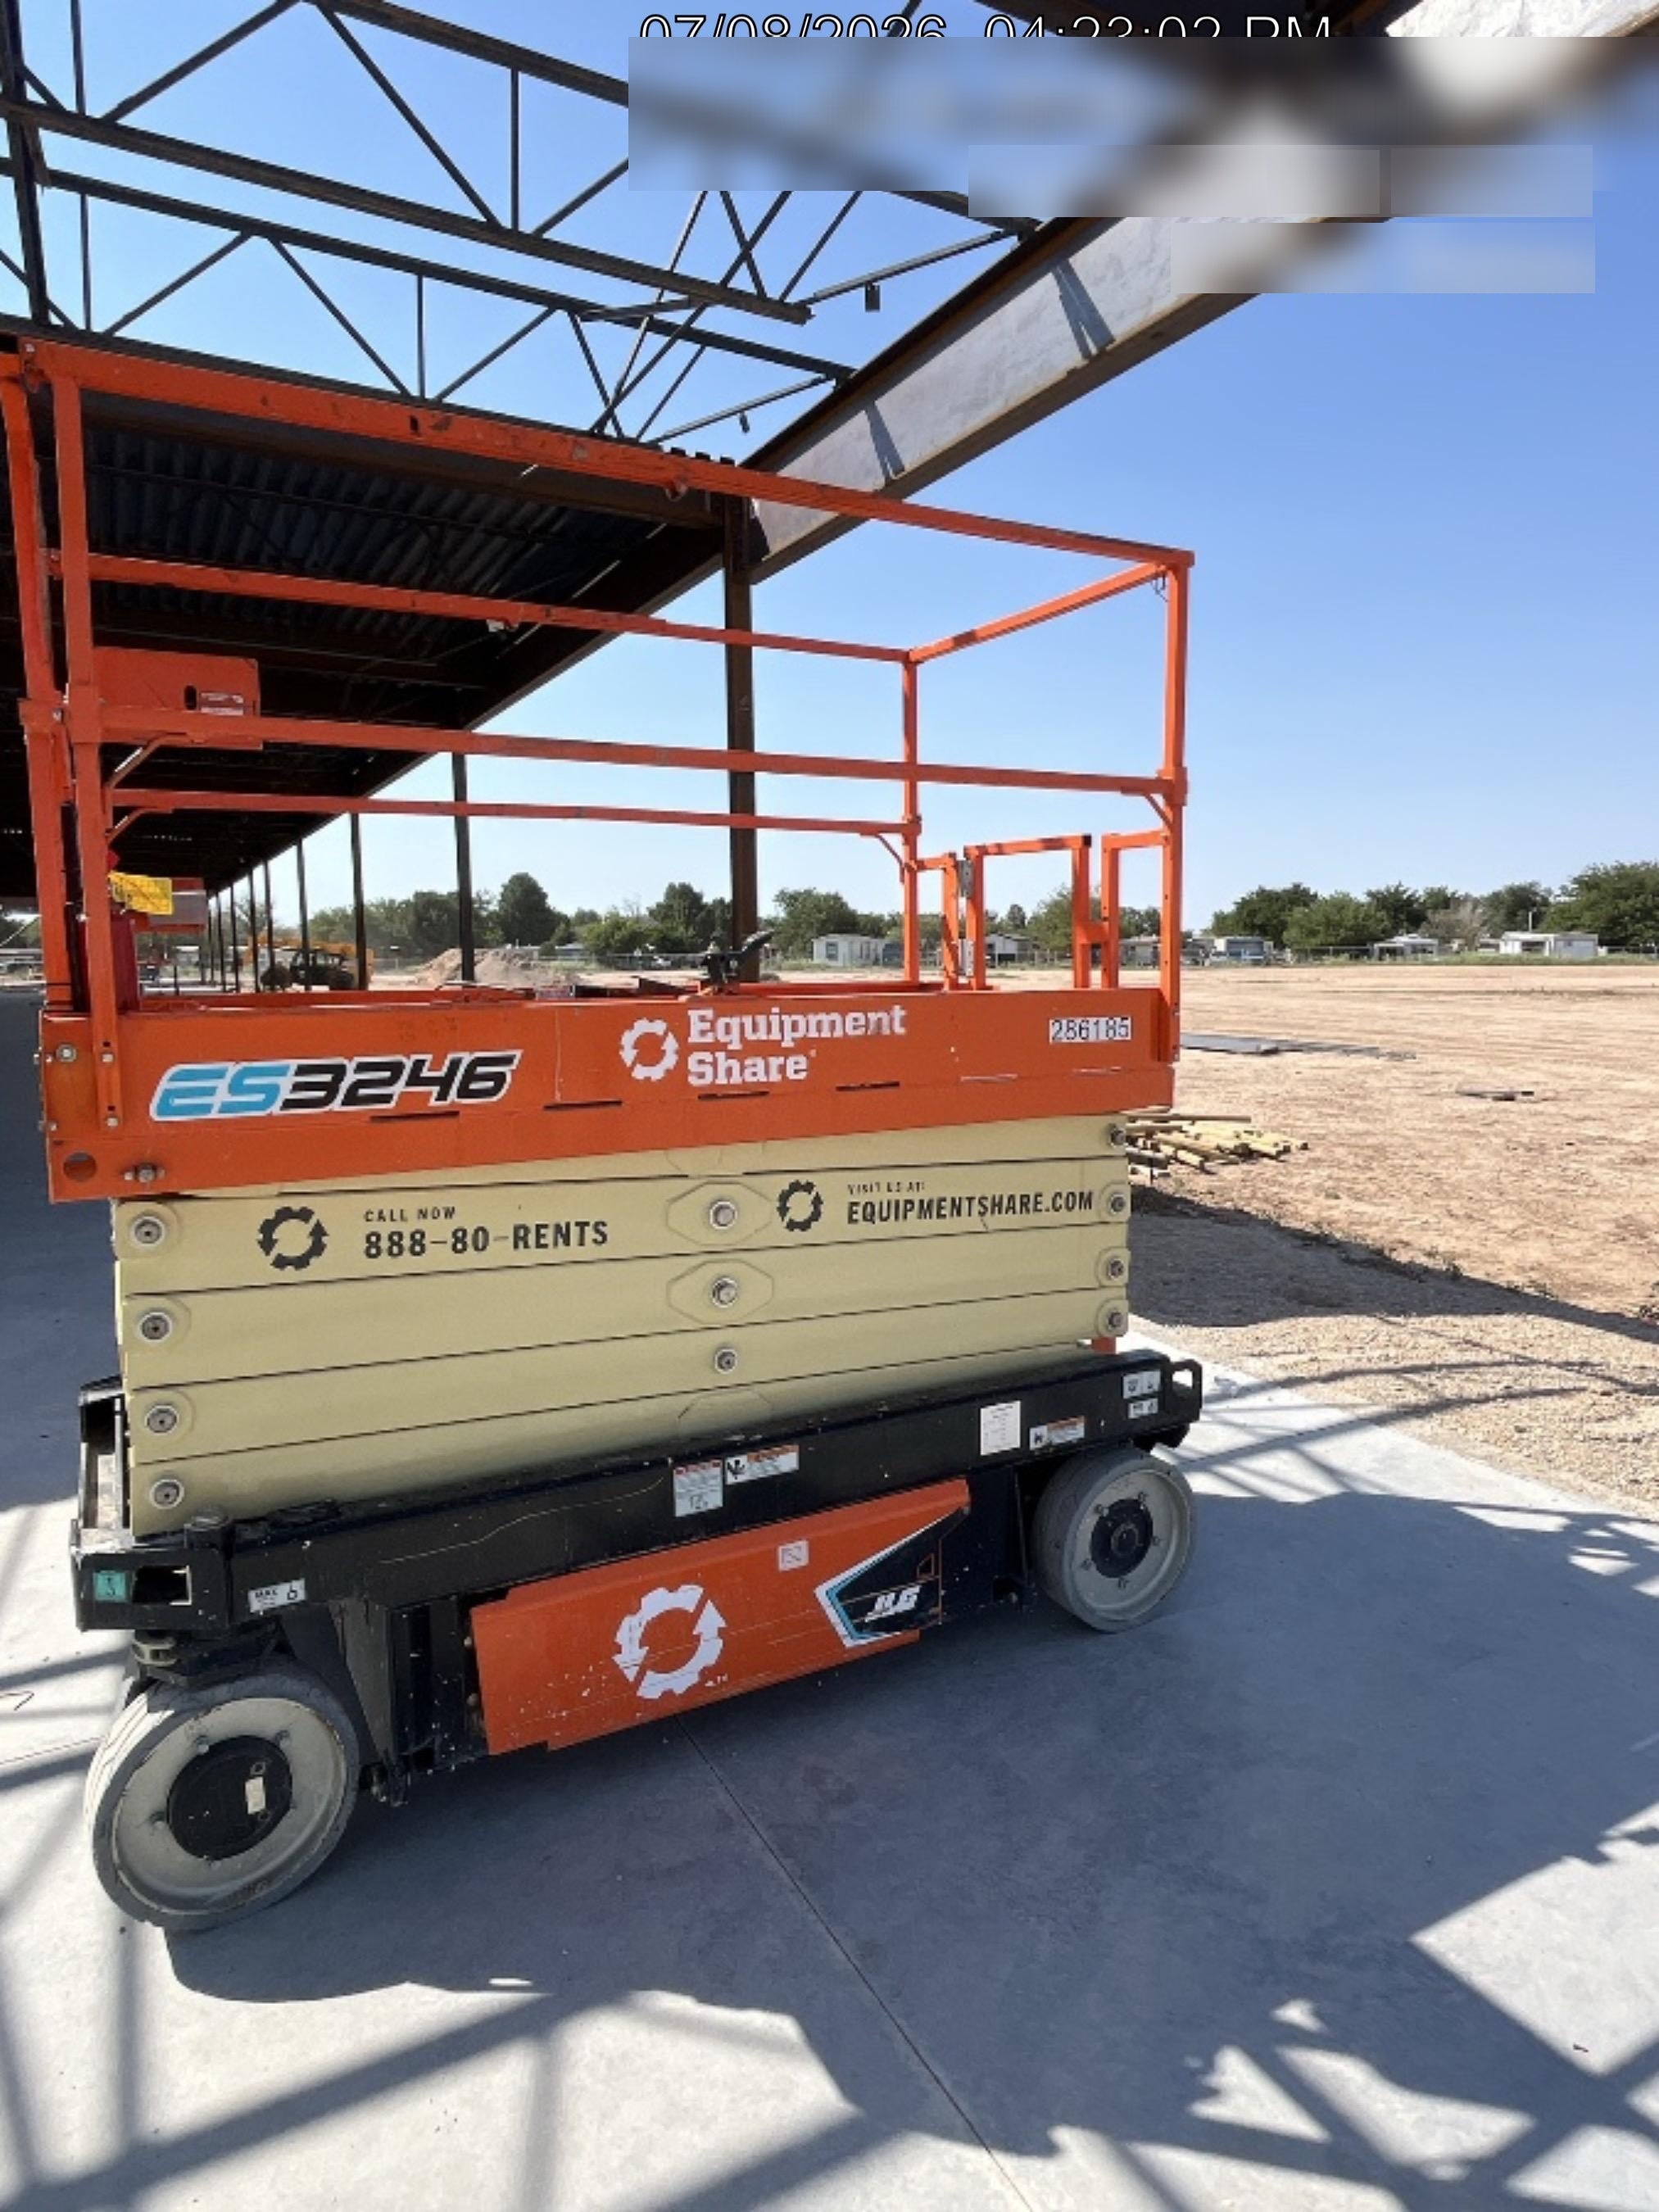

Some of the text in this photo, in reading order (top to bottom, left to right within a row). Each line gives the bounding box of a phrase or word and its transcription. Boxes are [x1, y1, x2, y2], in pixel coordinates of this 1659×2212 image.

[687, 1004, 907, 1049] Equipment
[1051, 1017, 1129, 1040] 286185
[150, 1049, 523, 1121] ES3246
[687, 1051, 809, 1086] Share
[364, 1206, 456, 1223] CALL NOW
[846, 1190, 1094, 1225] EQUIPMENTSHARE.COM
[364, 1220, 609, 1259] 888-80-RENTS
